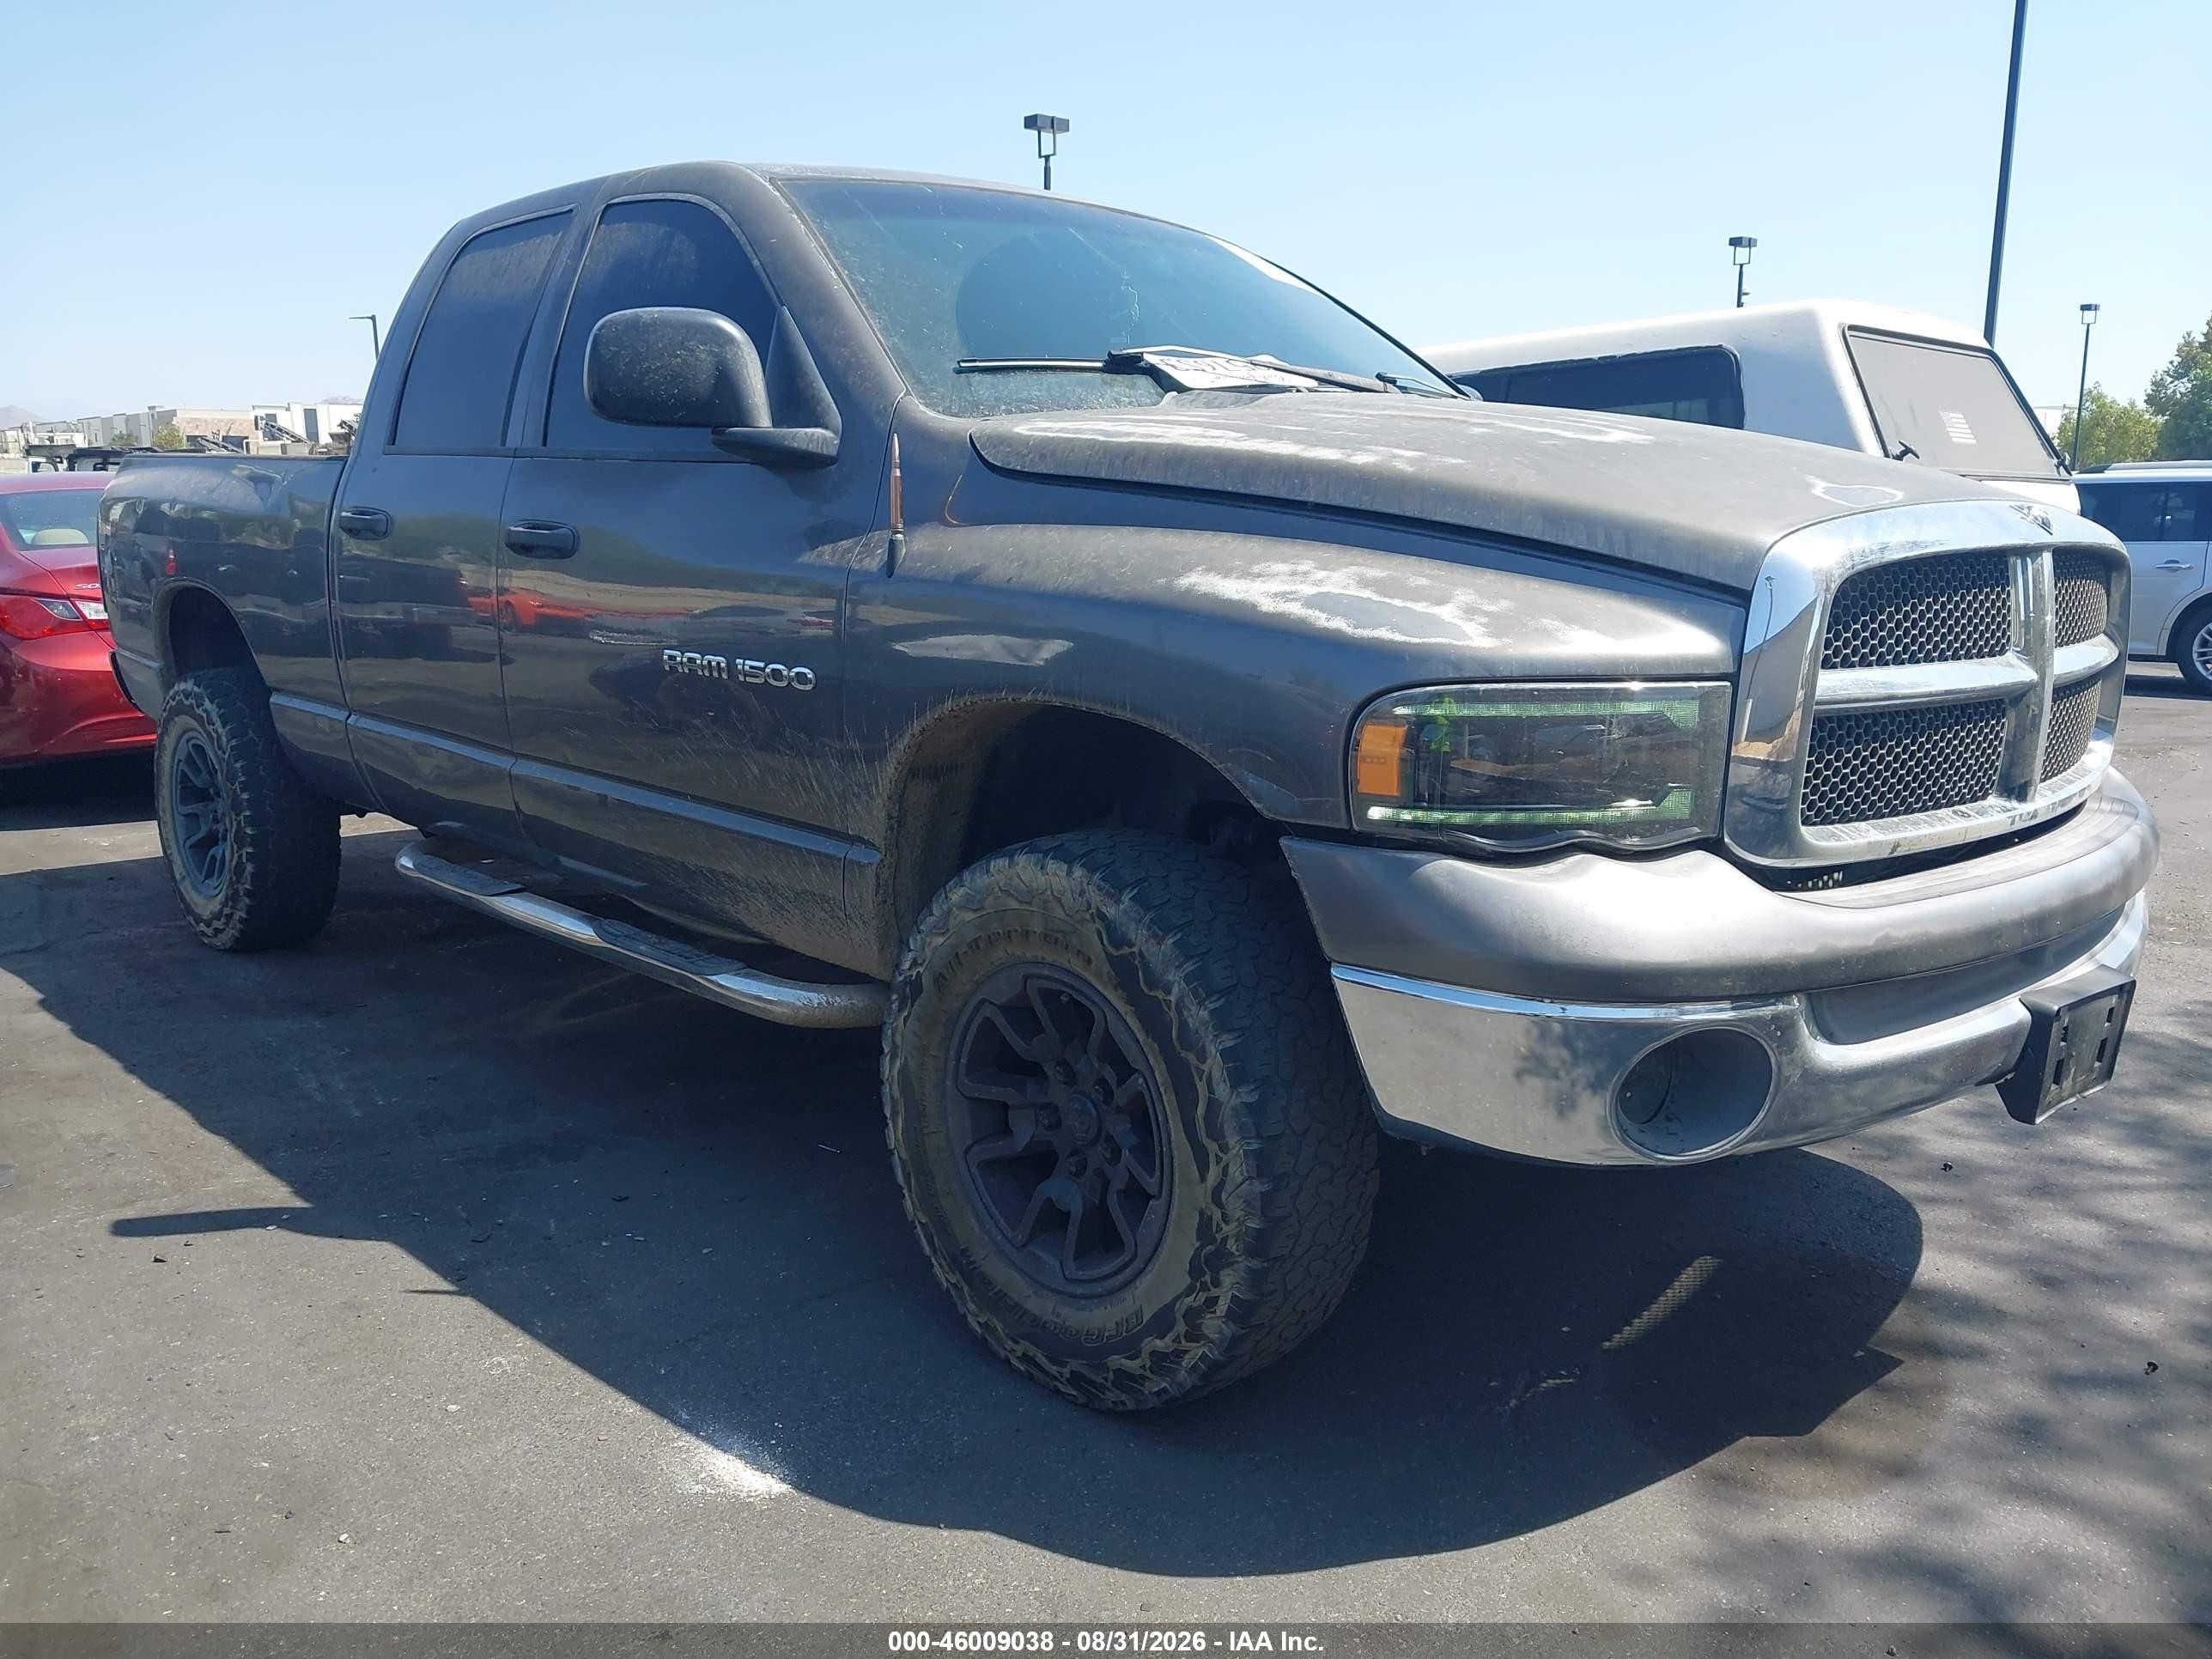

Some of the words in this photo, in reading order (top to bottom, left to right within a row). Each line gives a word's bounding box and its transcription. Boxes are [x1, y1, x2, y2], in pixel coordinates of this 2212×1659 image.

[662, 649, 729, 680] RAM
[735, 658, 817, 690] 1500
[933, 927, 1095, 993] All-Terrain
